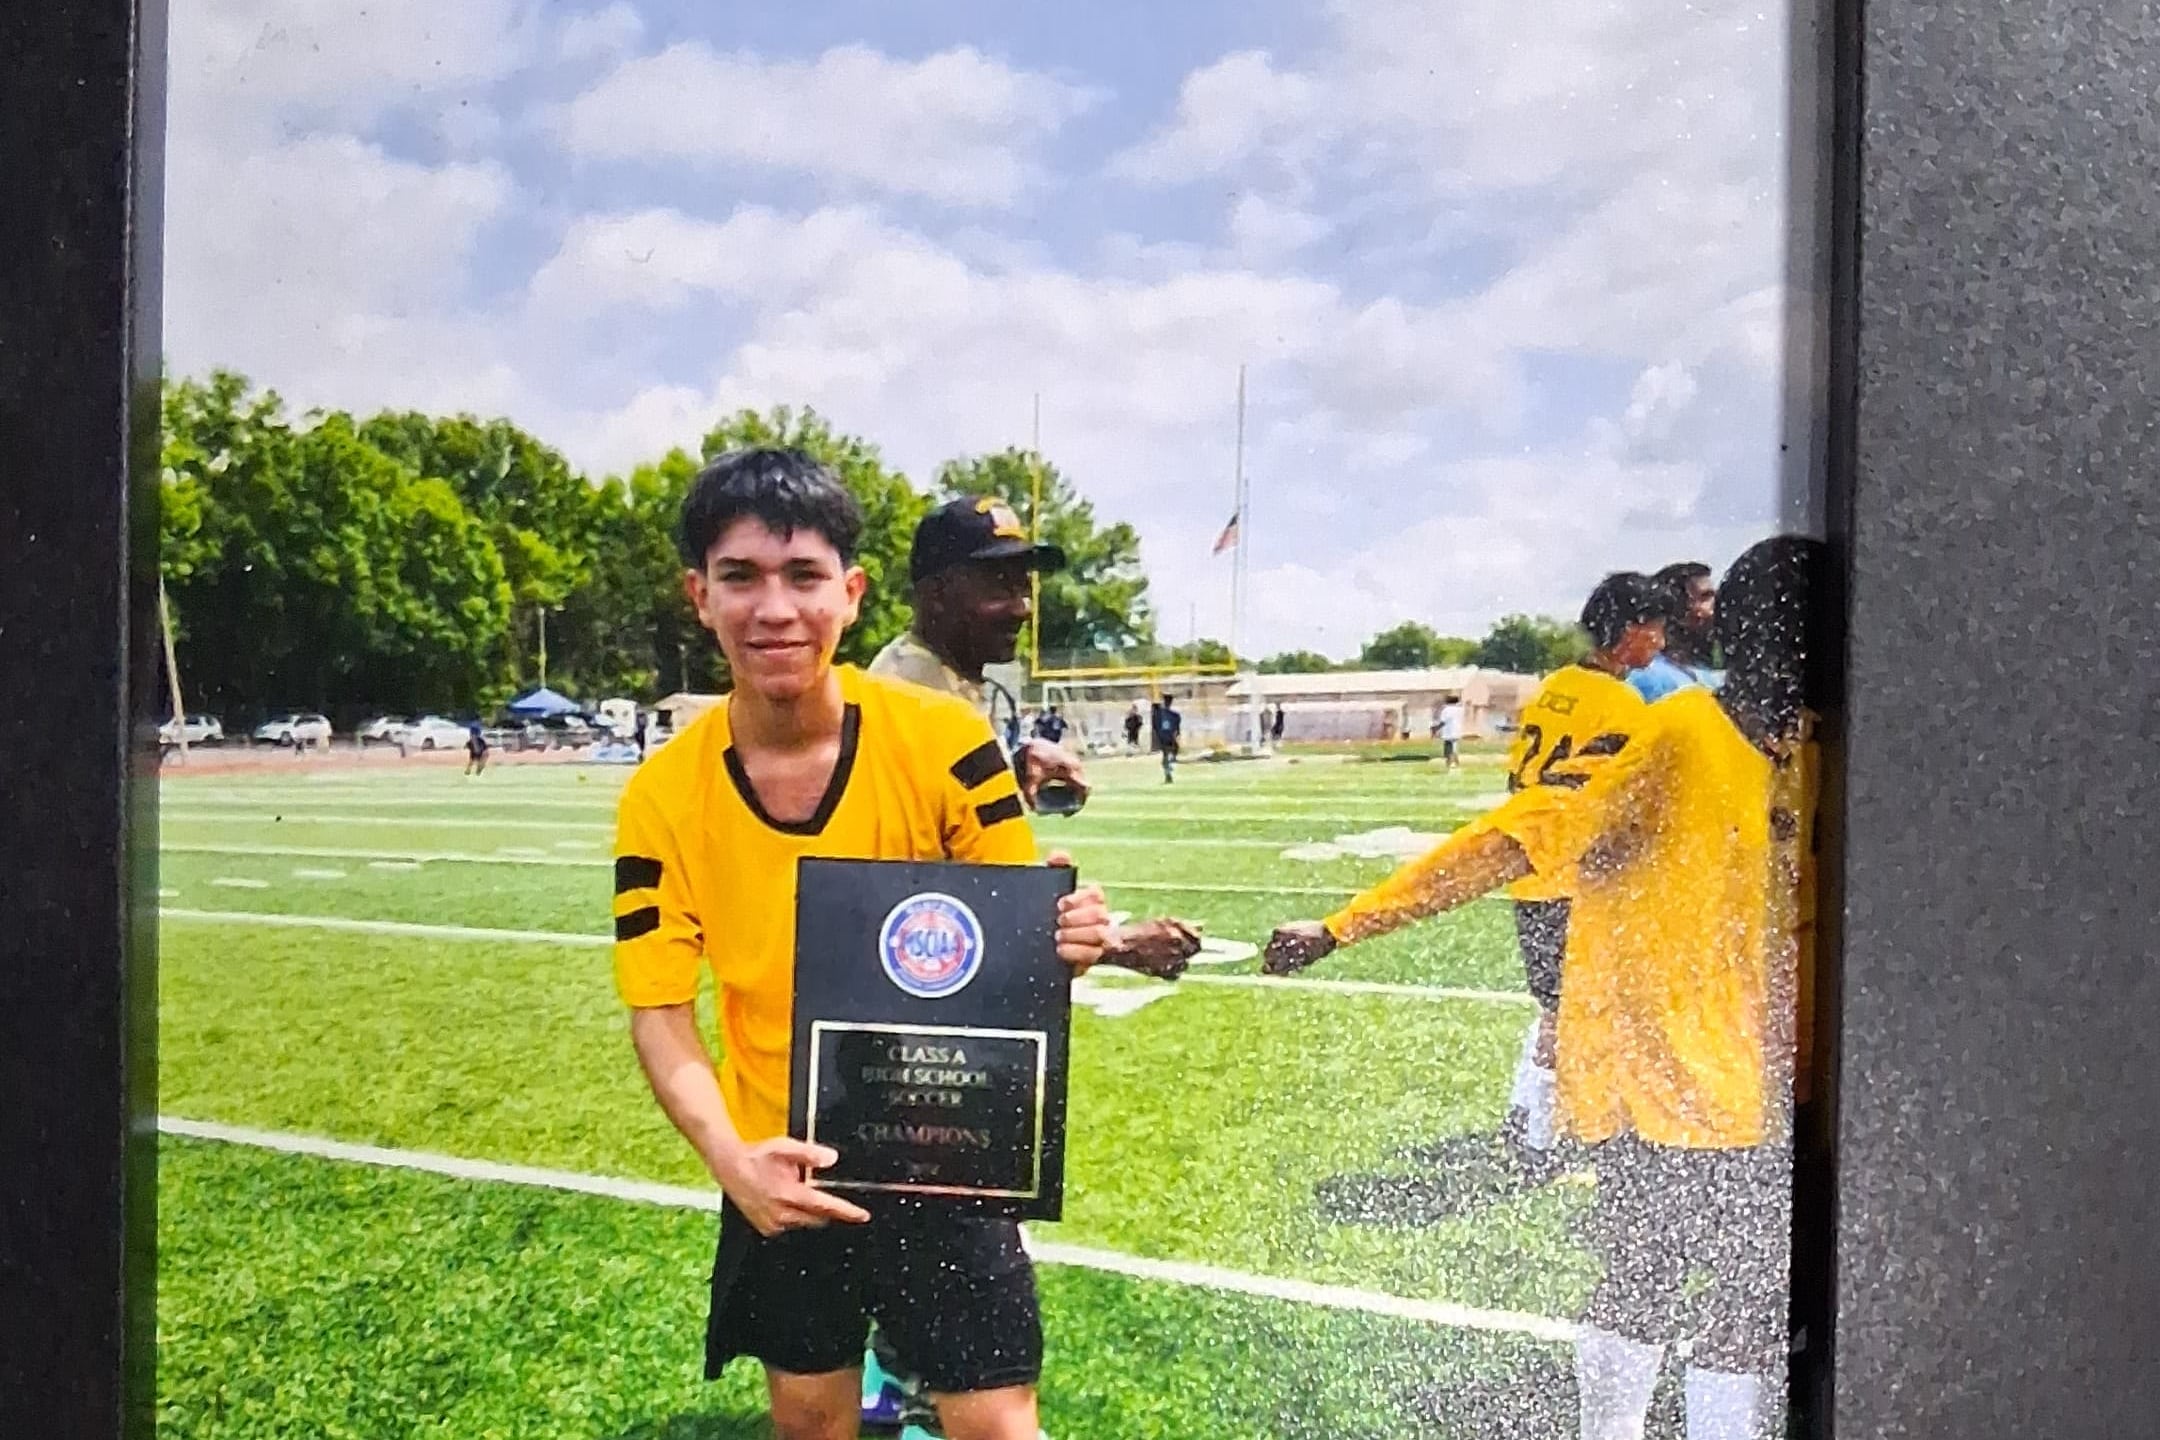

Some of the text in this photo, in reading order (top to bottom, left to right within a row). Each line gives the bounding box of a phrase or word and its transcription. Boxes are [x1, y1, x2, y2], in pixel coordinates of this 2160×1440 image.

[887, 1045, 968, 1065] CLASS A
[913, 1067, 991, 1088] SCHOOL
